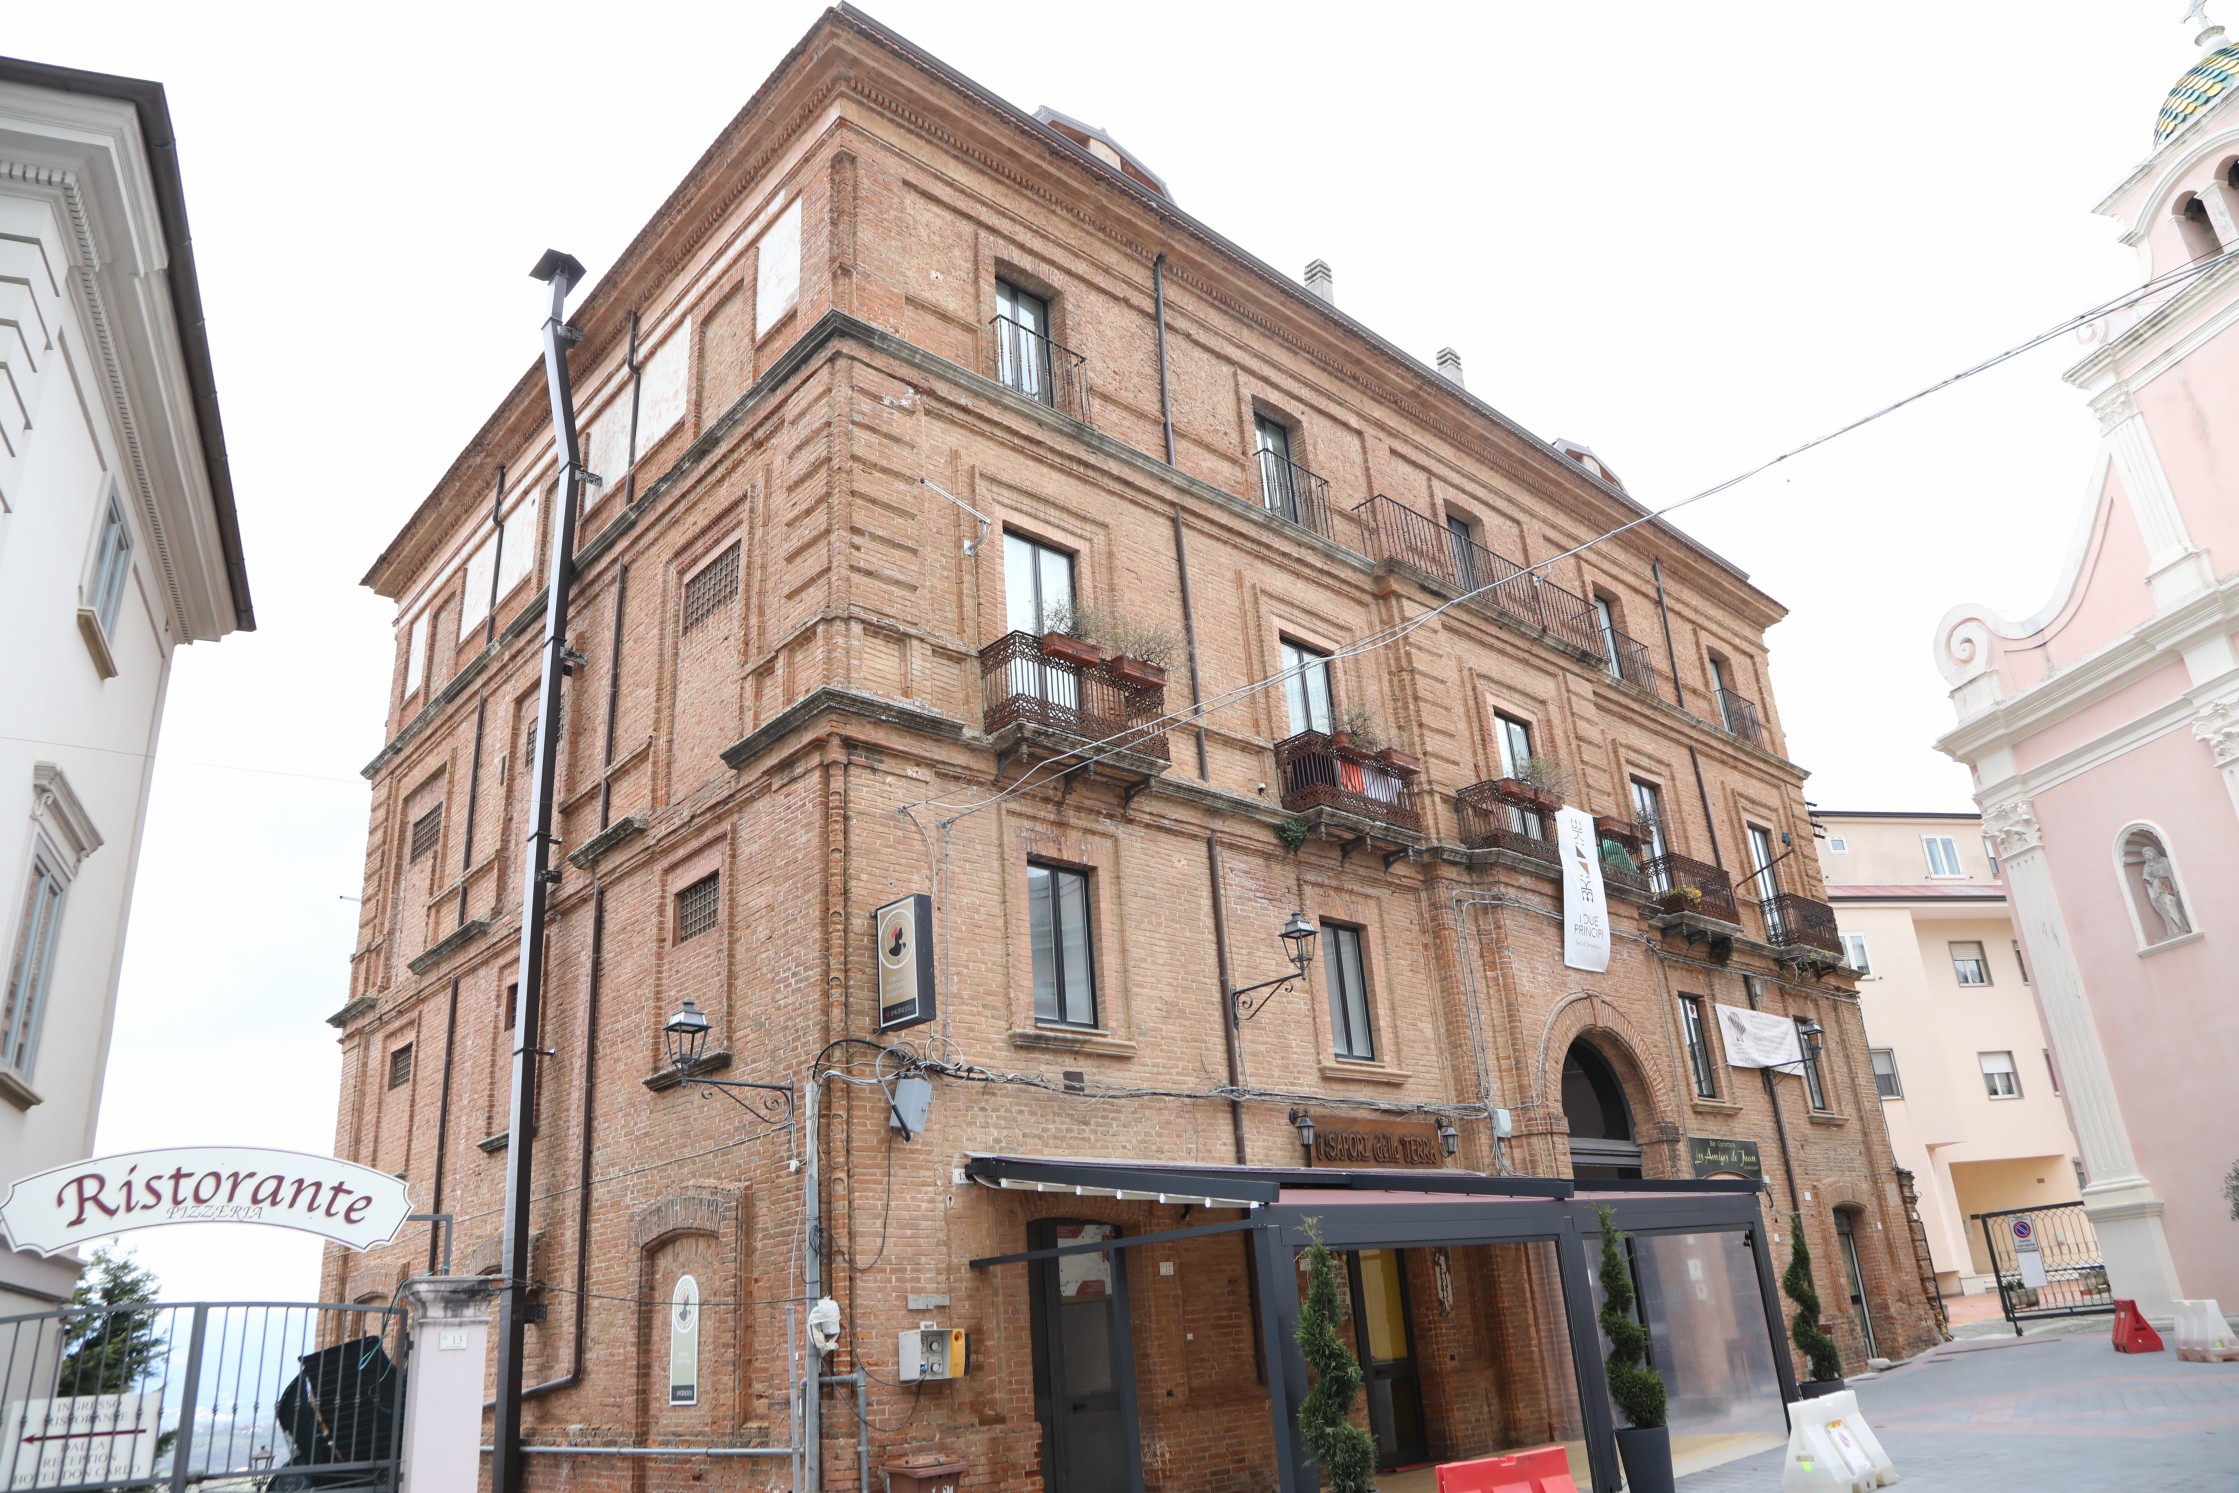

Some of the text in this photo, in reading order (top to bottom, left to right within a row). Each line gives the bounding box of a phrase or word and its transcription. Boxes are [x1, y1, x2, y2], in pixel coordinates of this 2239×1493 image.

[1583, 914, 1599, 926] DUE
[1574, 923, 1604, 939] PRINCIPI
[1326, 1131, 1370, 1160] SAPORI
[1374, 1133, 1400, 1162] della
[1400, 1134, 1438, 1164] TERRA
[1730, 1149, 1738, 1162] de
[1737, 1150, 1757, 1167] Juan
[57, 1163, 373, 1228] Ristorante
[166, 1204, 264, 1222] PIZZERIA
[452, 1335, 463, 1345] 13
[47, 1410, 128, 1427] RISORANE
[12, 1471, 59, 1485] HOEL
